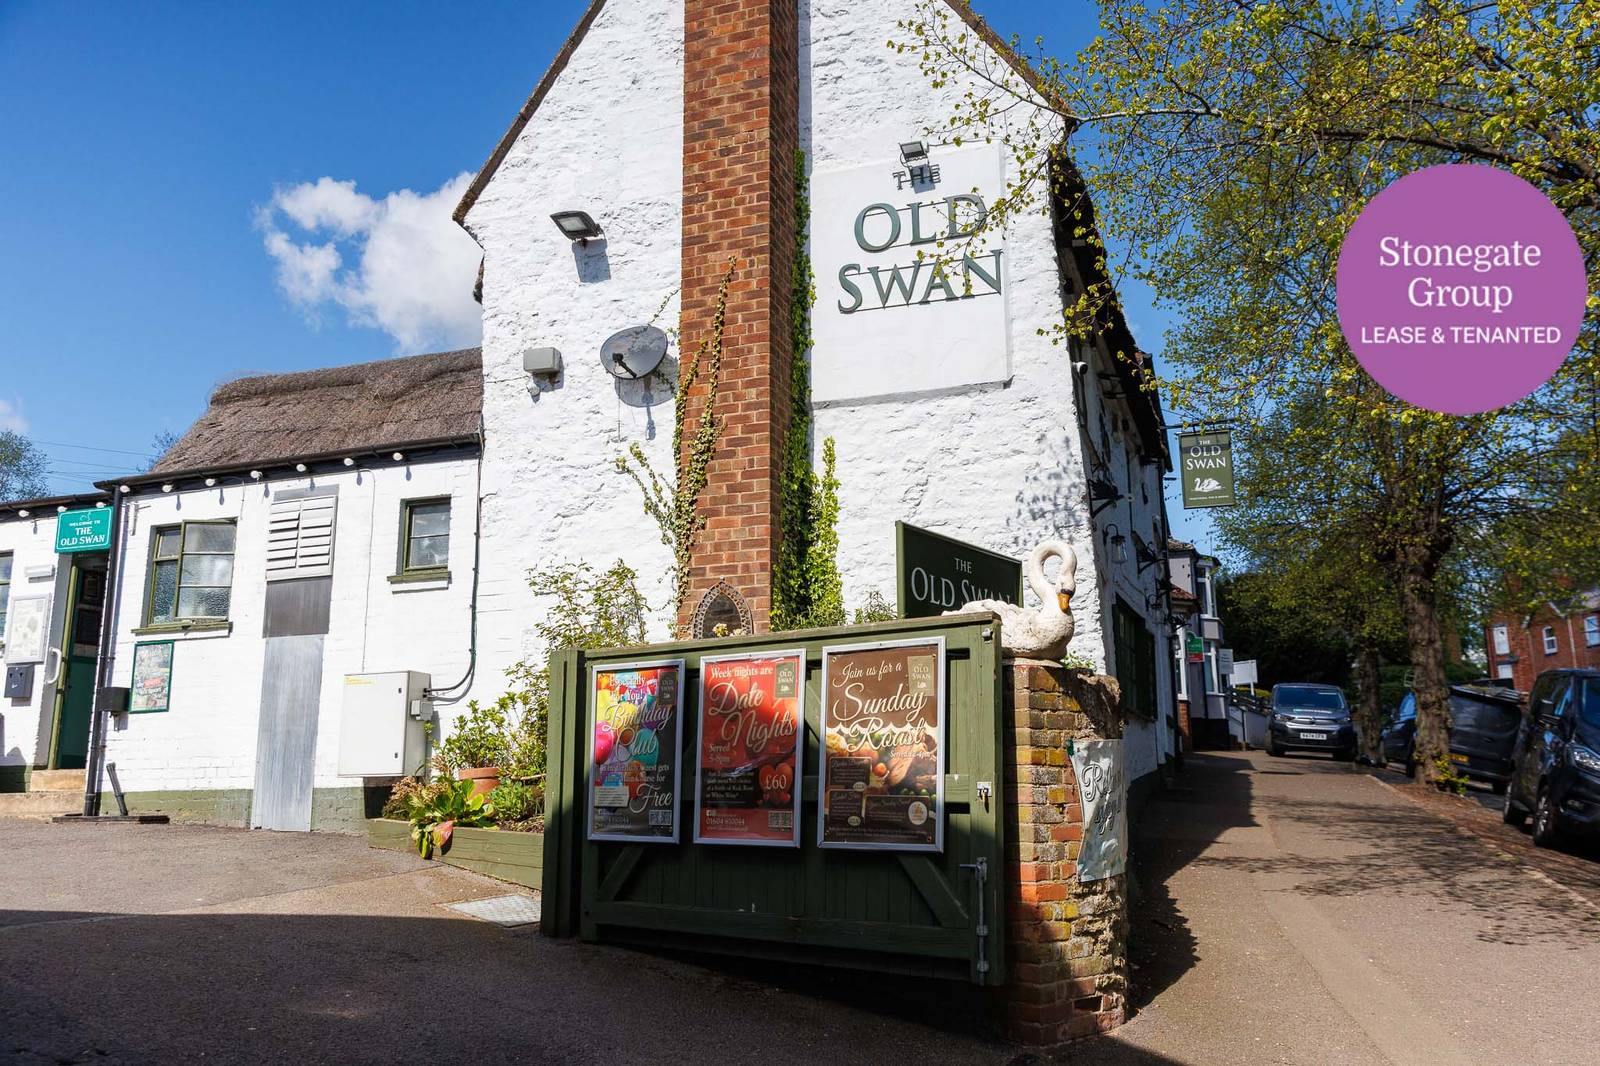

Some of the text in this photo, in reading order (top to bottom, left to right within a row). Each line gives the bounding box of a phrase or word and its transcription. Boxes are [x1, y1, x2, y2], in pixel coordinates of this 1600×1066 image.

[854, 193, 988, 254] OLD
[837, 248, 1003, 315] SWAN
[1190, 445, 1222, 458] OLD
[1186, 456, 1227, 471] SWAN
[60, 534, 105, 546] OLD SWAN
[75, 526, 93, 536] THE
[954, 557, 973, 575] THE
[710, 664, 774, 679] Week nights are
[779, 670, 793, 678] OLD
[832, 660, 903, 688] Join us for a
[912, 672, 931, 681] SWAN
[913, 665, 929, 674] OLD
[708, 681, 764, 716] Date
[833, 682, 928, 722] Sunday
[602, 700, 673, 732] Birthday
[721, 710, 796, 752] Nights
[847, 716, 927, 753] Roast
[615, 727, 658, 761] Club
[765, 774, 787, 790] £60
[629, 783, 673, 814] Free
